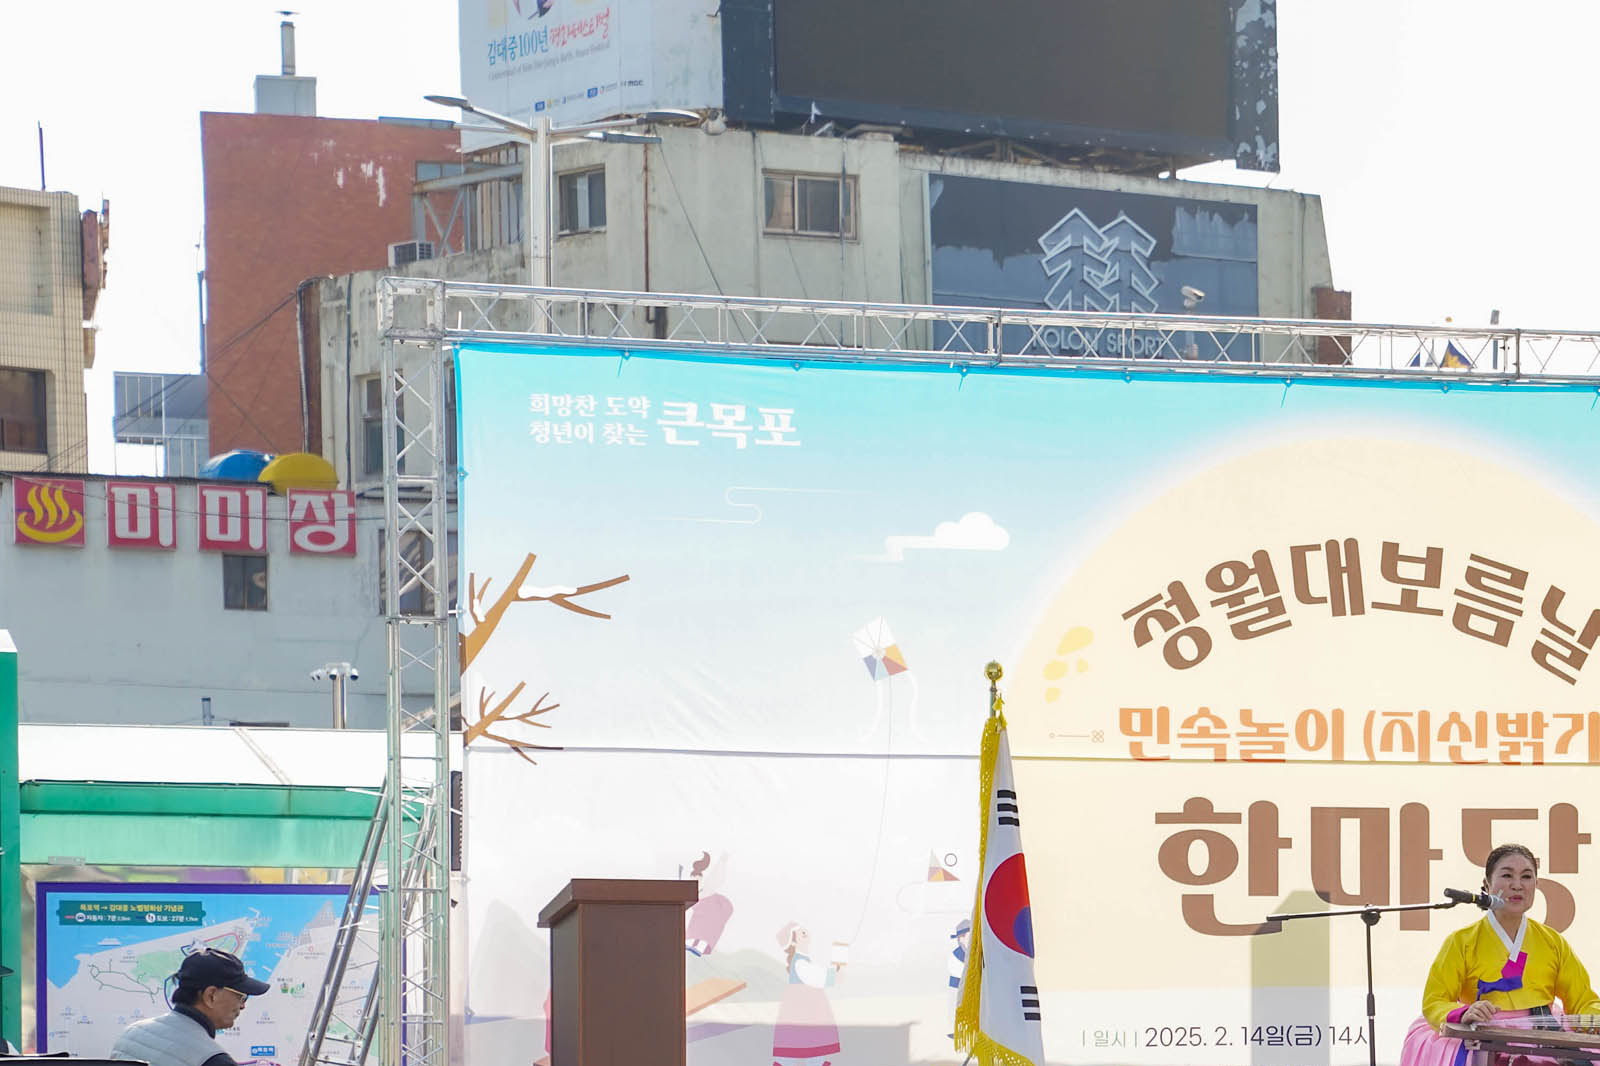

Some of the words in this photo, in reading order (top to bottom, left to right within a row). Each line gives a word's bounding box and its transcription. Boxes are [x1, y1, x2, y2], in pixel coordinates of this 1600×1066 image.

[1032, 328, 1099, 353] KOLON
[1106, 332, 1166, 356] SPORT
[529, 393, 598, 418] 희망찬
[604, 395, 652, 419] 도약
[656, 399, 802, 450] 큰목포
[529, 420, 596, 445] 청년이
[602, 422, 649, 446] 찾는
[110, 485, 355, 553] 미미장
[1118, 705, 1345, 763] 민속놀이
[1154, 796, 1592, 937] 한마당
[1093, 1030, 1127, 1048] 일시
[1144, 1027, 1208, 1047] 2025.
[1214, 1027, 1234, 1047] 2.
[1241, 1025, 1323, 1047] 14일(금)
